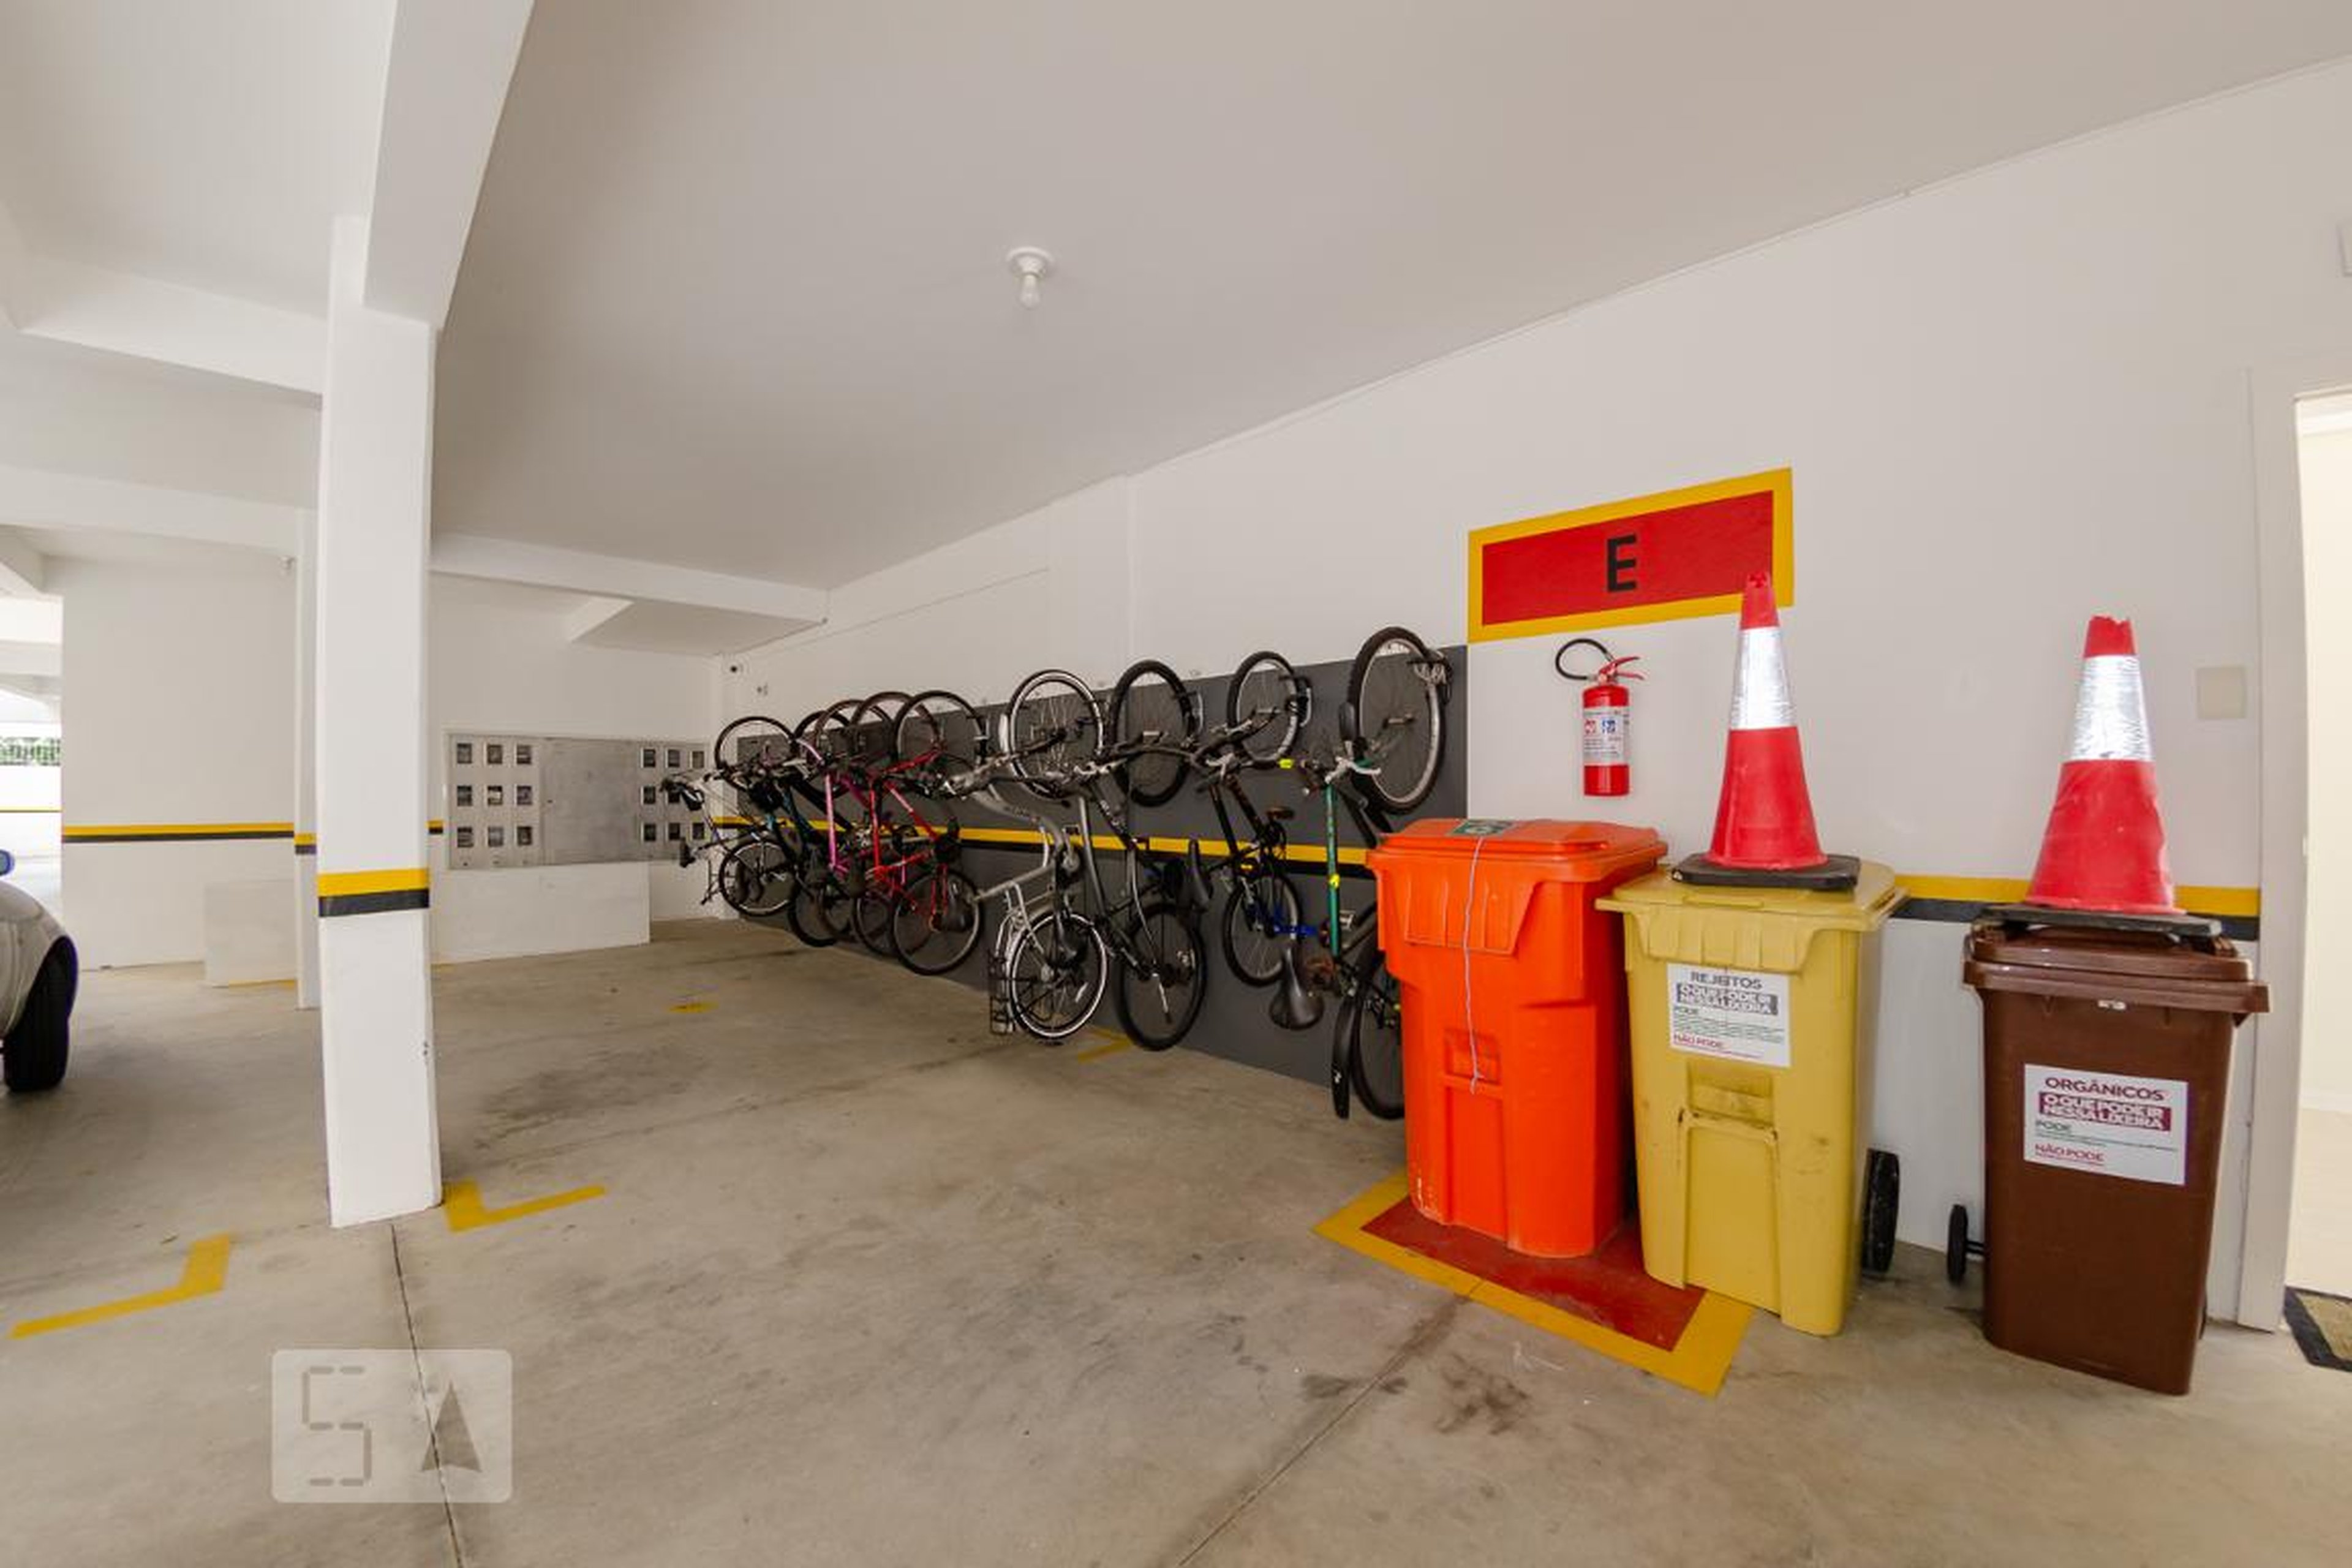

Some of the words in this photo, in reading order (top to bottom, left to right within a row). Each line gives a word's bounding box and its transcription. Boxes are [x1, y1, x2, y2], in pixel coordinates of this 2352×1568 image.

[1606, 533, 1637, 592] E
[2045, 1076, 2165, 1101] ORGÂNICOS
[2035, 1143, 2064, 1156] NÃO
[2065, 1147, 2104, 1162] PODE
